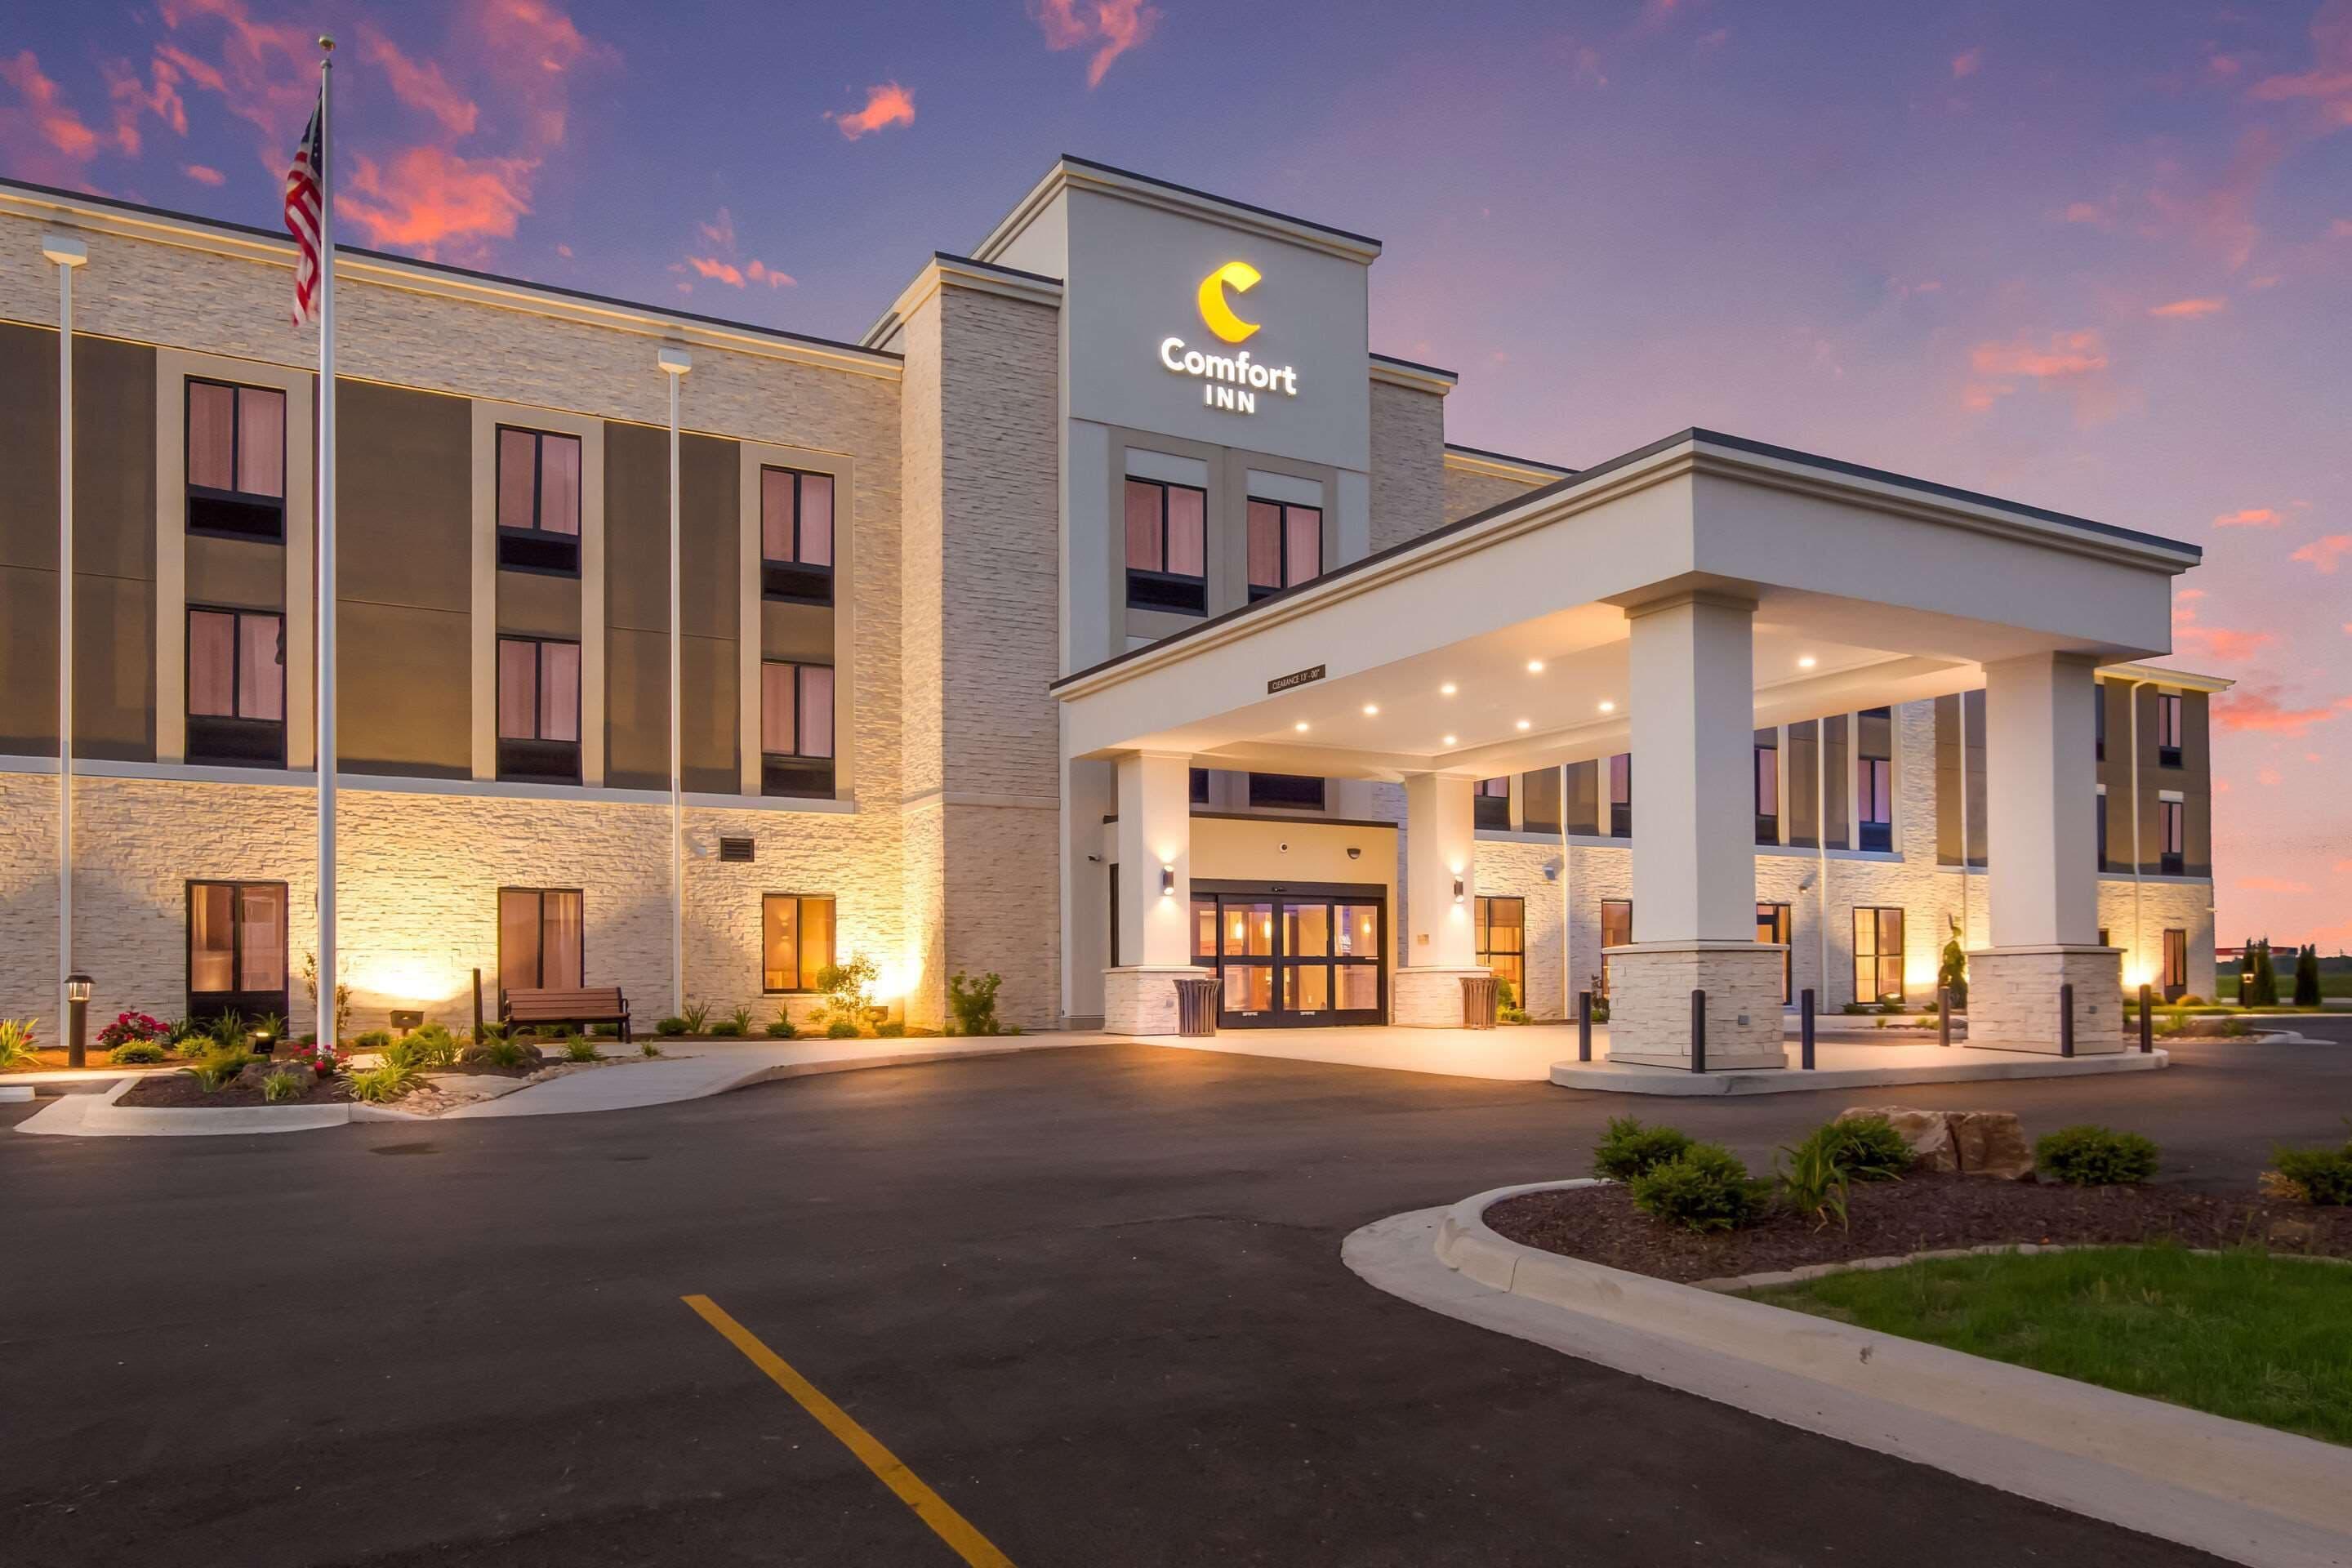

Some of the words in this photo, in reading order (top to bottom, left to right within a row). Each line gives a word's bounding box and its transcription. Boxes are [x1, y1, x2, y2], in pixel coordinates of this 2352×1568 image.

[1160, 336, 1297, 395] Comfort
[1205, 384, 1254, 413] INN
[1272, 675, 1299, 690] CLEARANCE
